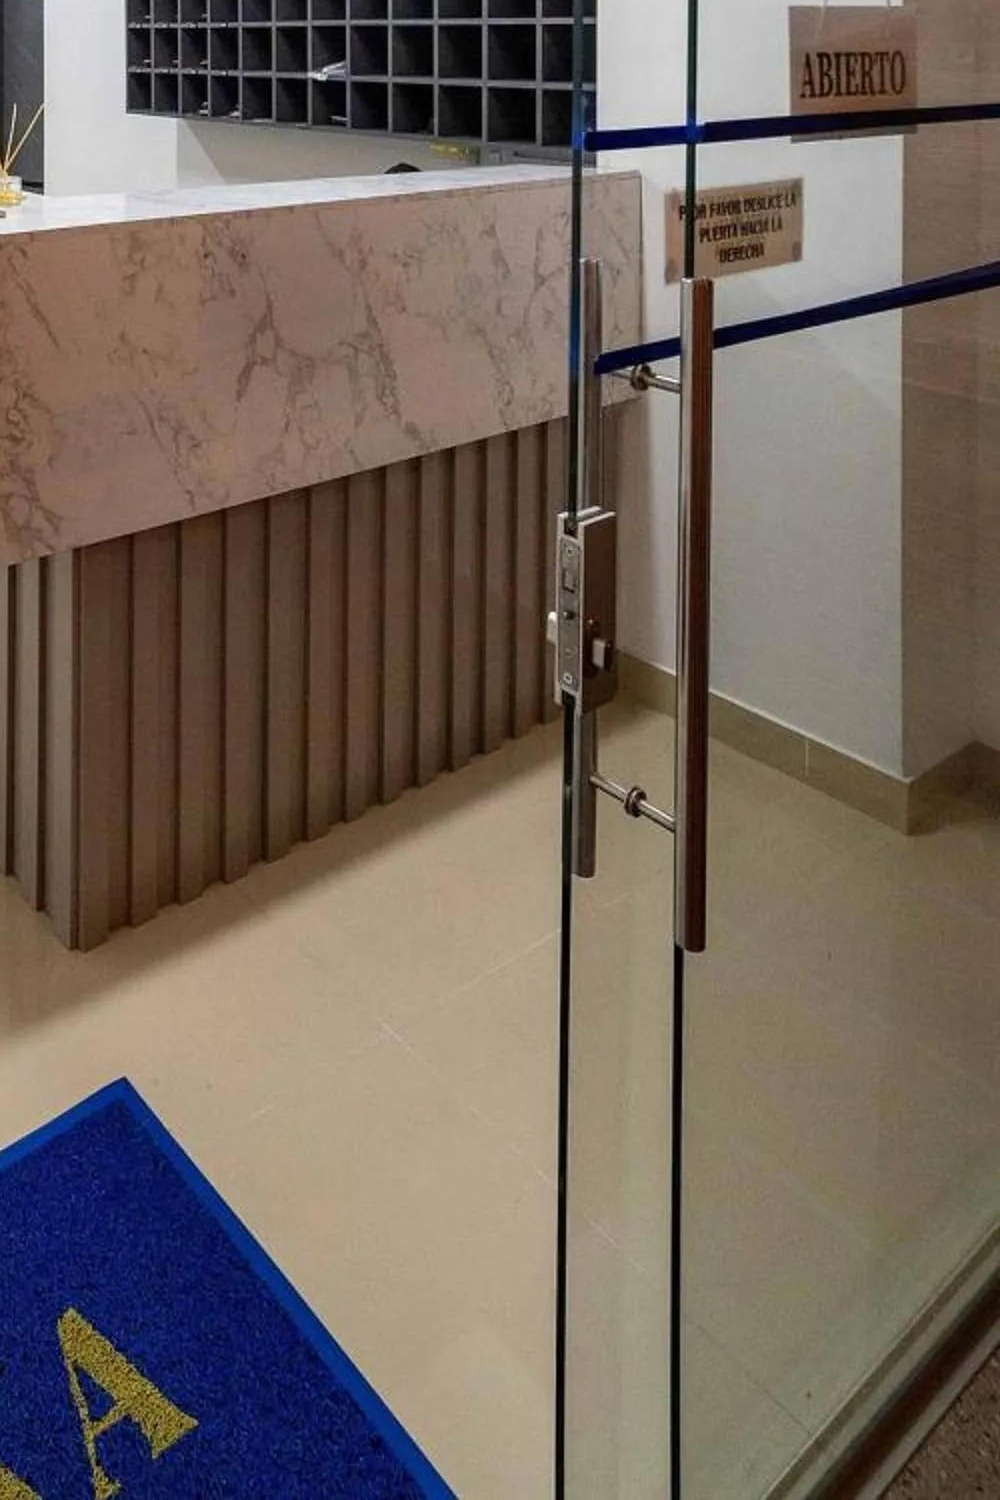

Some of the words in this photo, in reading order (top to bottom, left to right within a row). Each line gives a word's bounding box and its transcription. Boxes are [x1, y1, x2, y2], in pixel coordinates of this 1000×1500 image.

[800, 50, 907, 99] ABIERTO
[709, 199, 742, 219] FAVOR
[744, 194, 783, 214] DESLICE
[785, 190, 797, 208] LA
[699, 223, 738, 244] PUERTA
[740, 219, 769, 237] HACIA
[771, 215, 784, 232] LA
[718, 242, 765, 264] DERECHA
